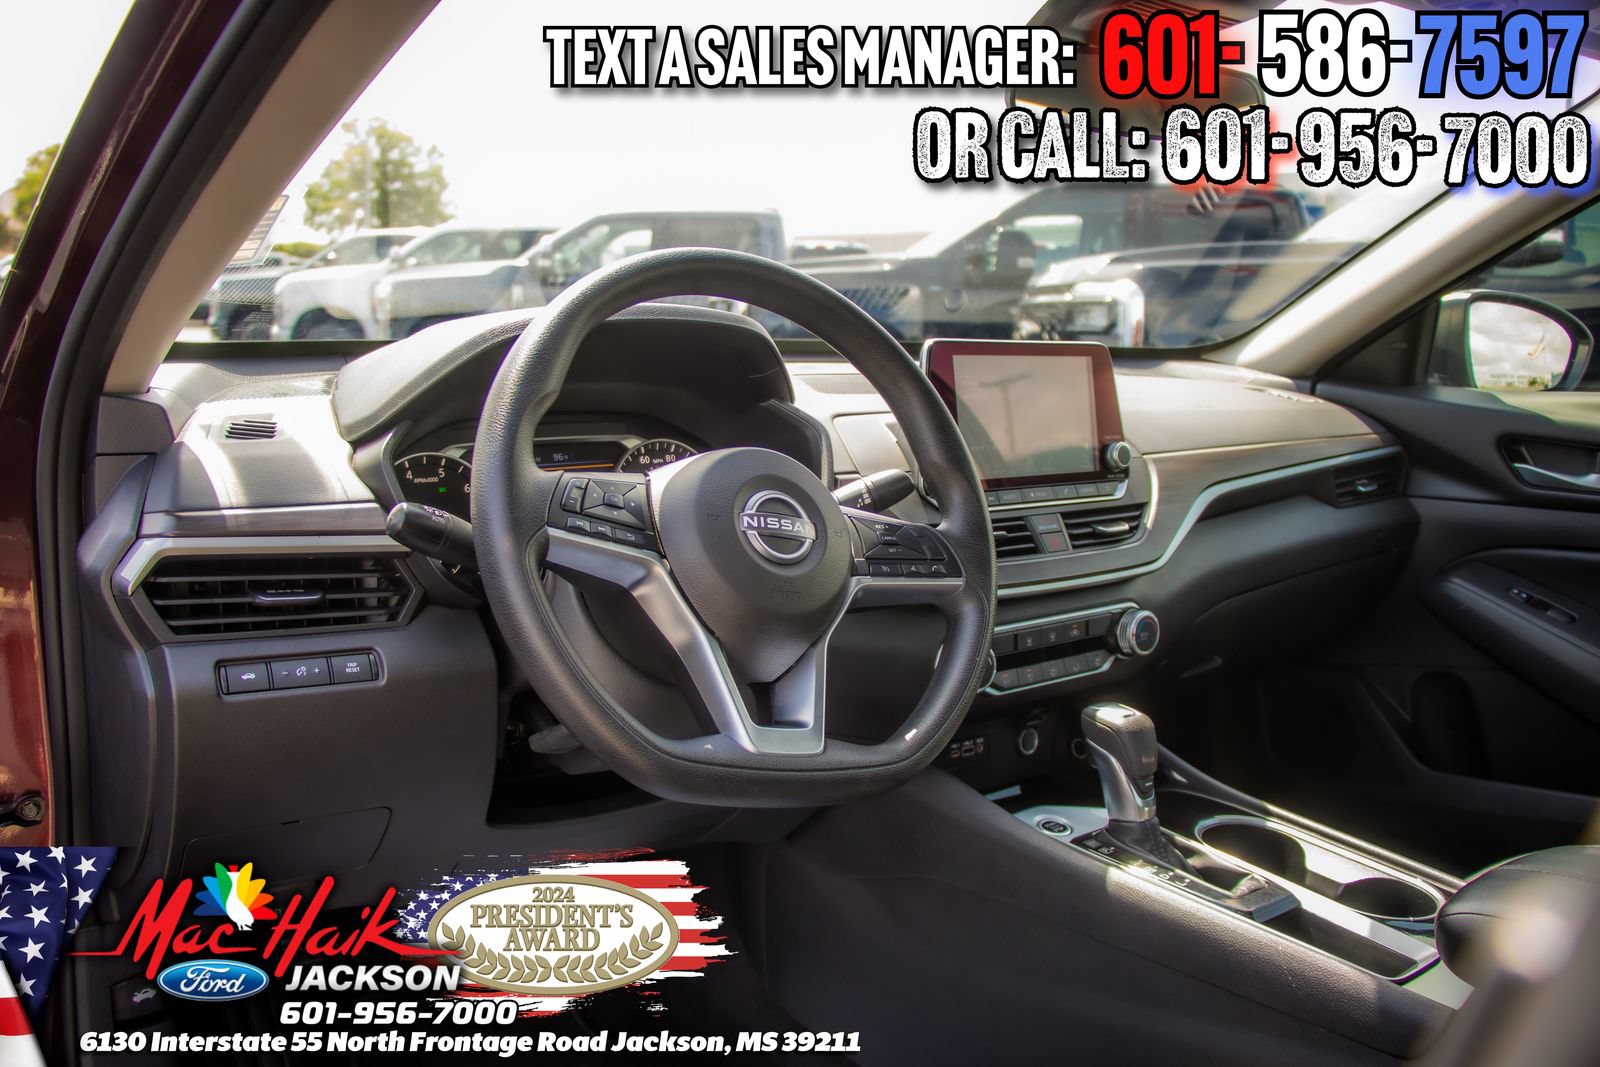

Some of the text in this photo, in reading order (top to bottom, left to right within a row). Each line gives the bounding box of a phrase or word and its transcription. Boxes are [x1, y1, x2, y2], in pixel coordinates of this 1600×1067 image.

[640, 455, 650, 464] 60
[665, 454, 676, 463] 80
[406, 469, 413, 479] 4
[438, 468, 445, 478] 5
[464, 483, 471, 493] 6
[742, 515, 815, 537] NISSAN
